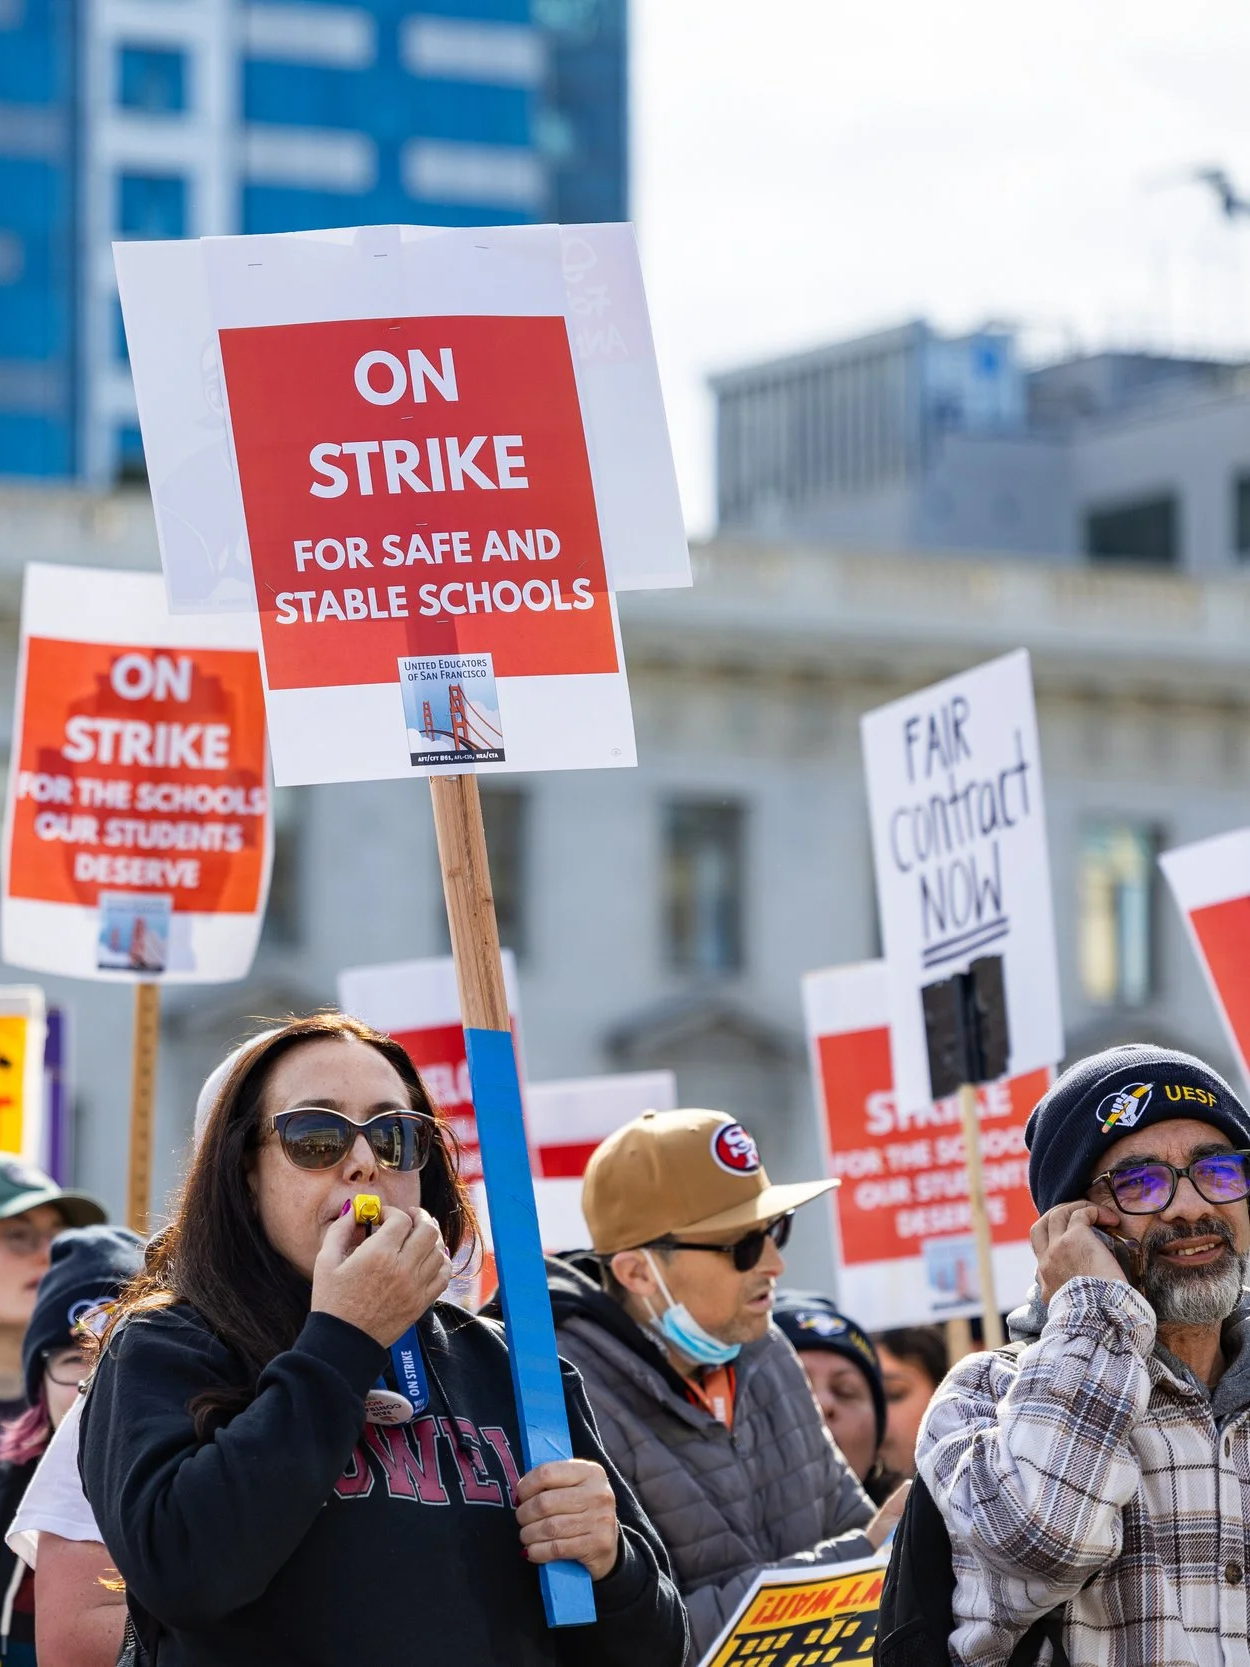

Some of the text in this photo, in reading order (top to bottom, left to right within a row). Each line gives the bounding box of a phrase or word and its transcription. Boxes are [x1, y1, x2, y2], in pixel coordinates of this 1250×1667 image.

[354, 347, 459, 406] ON
[309, 434, 529, 499] STRIKE
[293, 528, 561, 572] FOR SAFE AND
[275, 578, 595, 625] STABLE SCHOOLS
[110, 651, 193, 702] ON
[404, 659, 487, 671] UNITED EDUCATORS
[420, 670, 438, 681] SAN
[440, 669, 487, 680] FRANCISCO
[61, 714, 231, 770] STRIKE
[903, 695, 973, 784] FAIR
[16, 770, 268, 817] FOR THE SCHOOLS
[34, 810, 244, 854] OUR STUDENTS
[73, 851, 200, 890] DESERVE
[919, 840, 1004, 940] NOW
[1164, 1085, 1218, 1107] UESF
[400, 1349, 420, 1396] ON STRIKE
[749, 1586, 842, 1626] WAIT!
